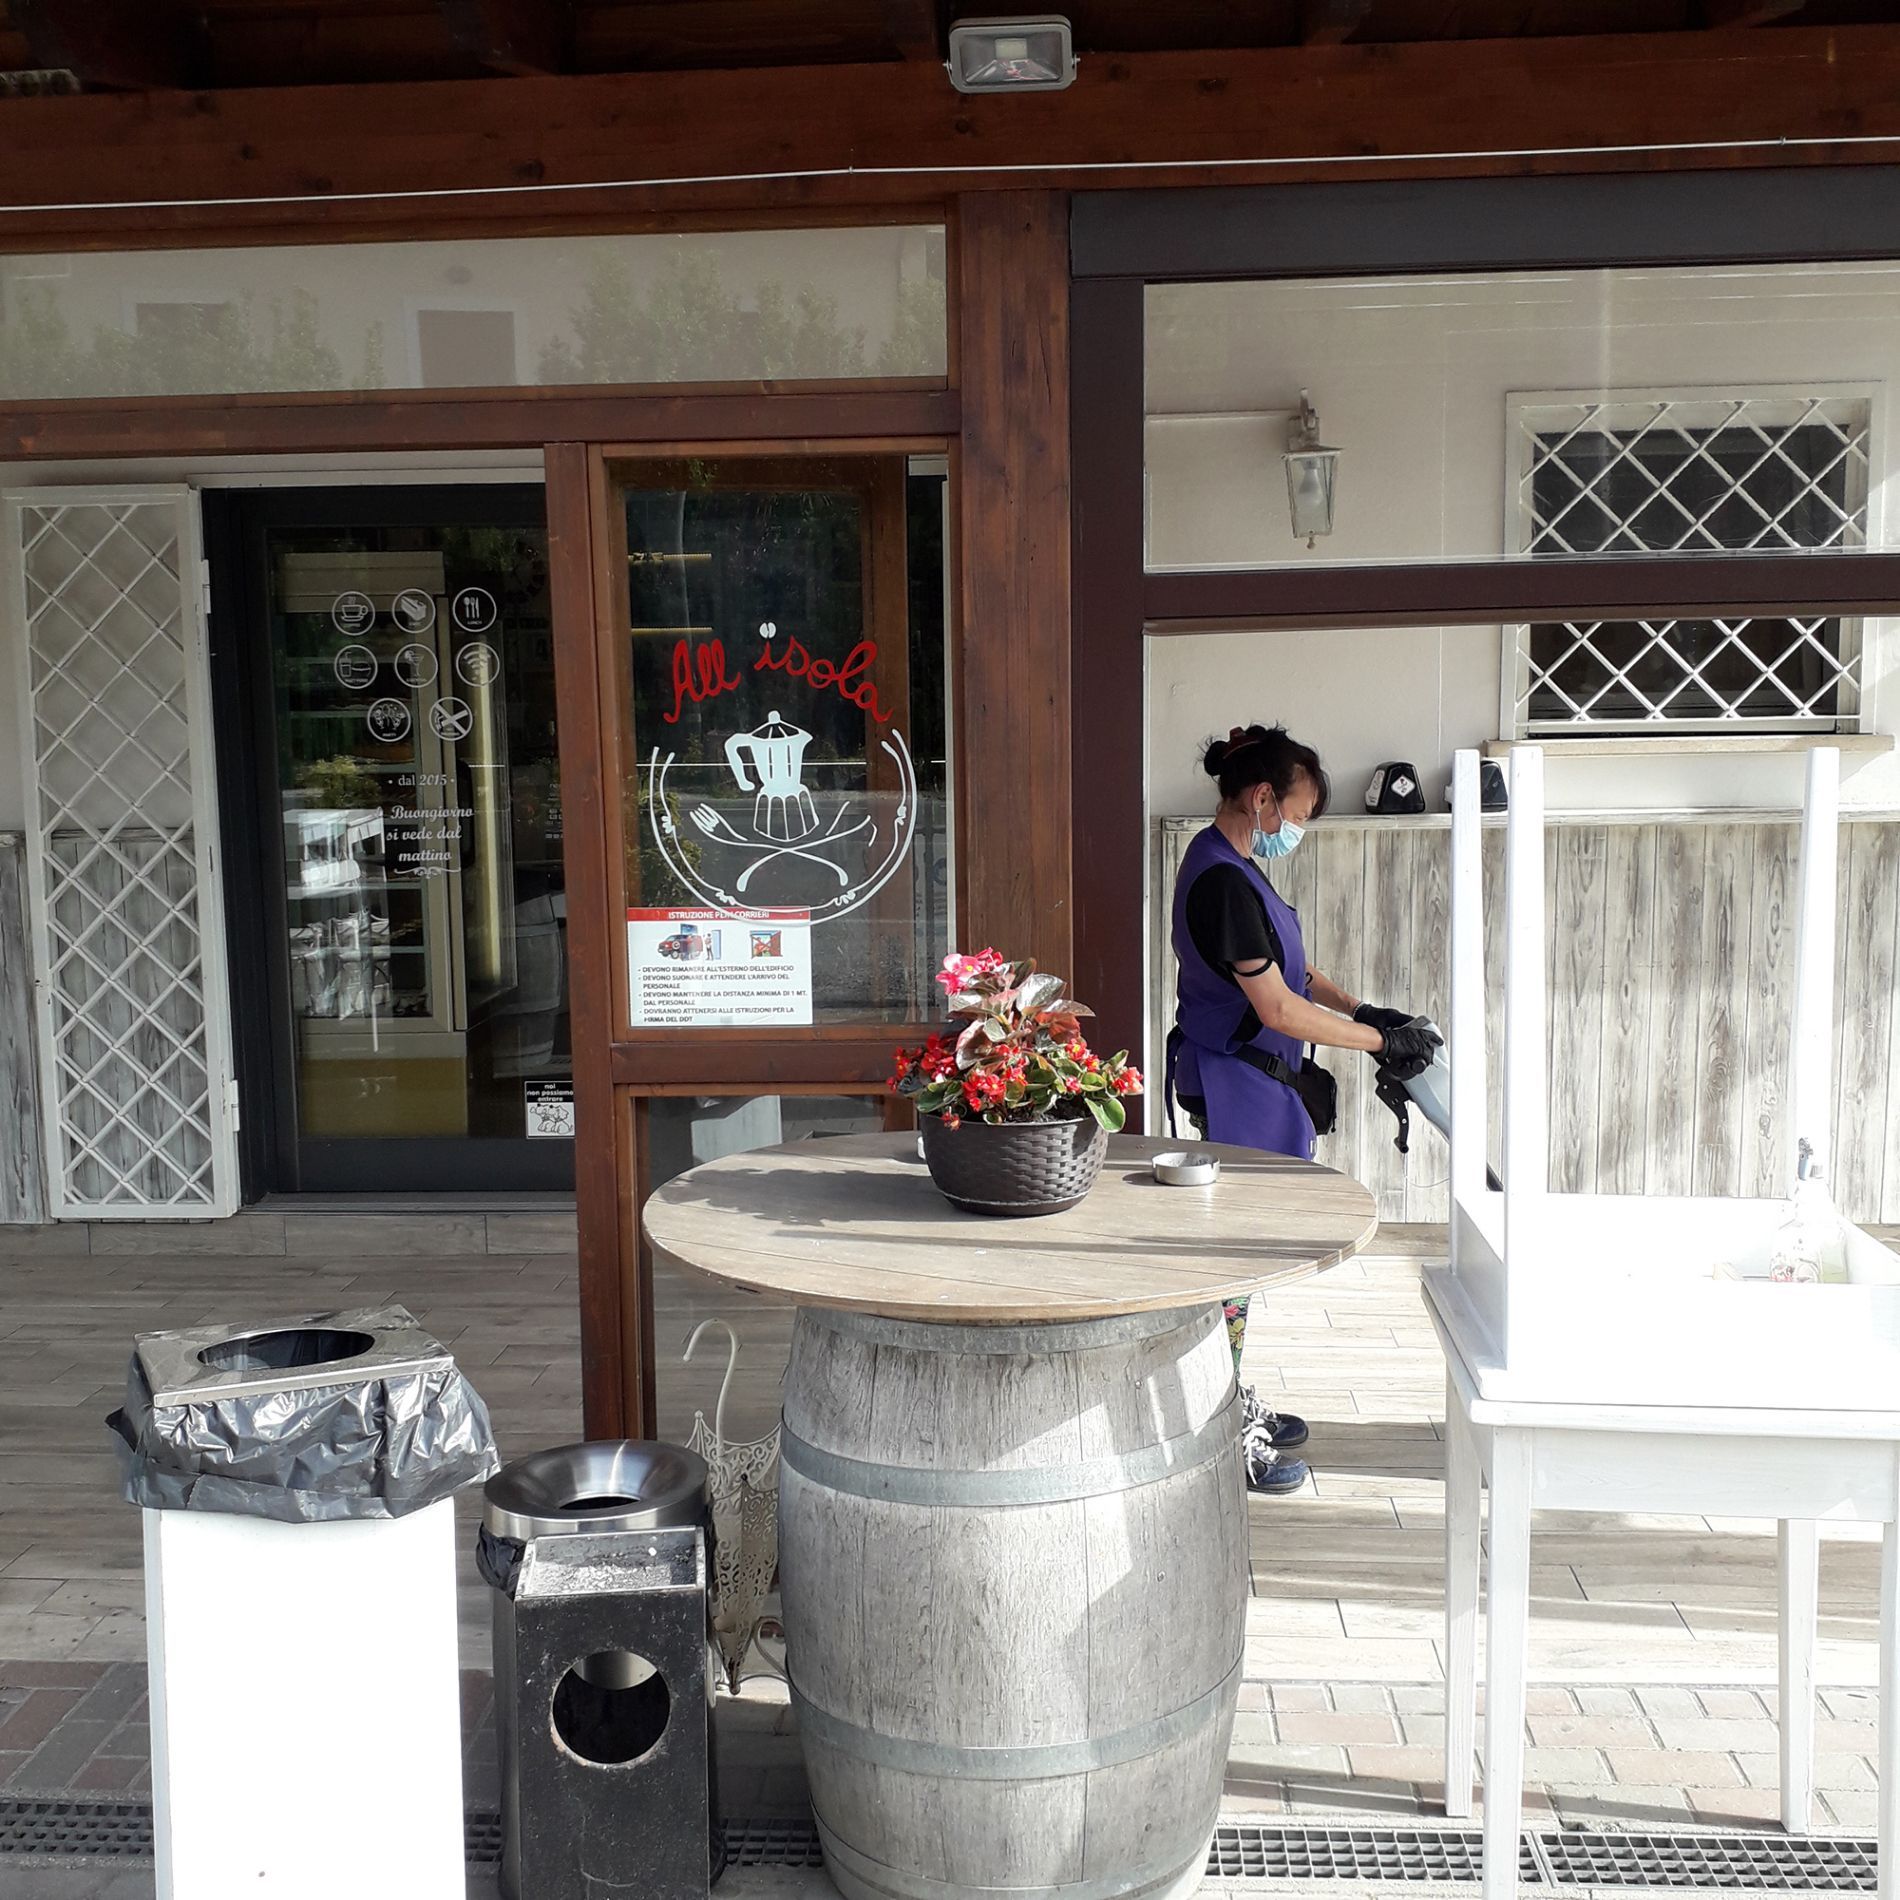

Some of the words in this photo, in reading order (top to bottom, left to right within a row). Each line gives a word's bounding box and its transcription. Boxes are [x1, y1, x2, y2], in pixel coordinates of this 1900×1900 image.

[663, 638, 741, 724] All
[754, 622, 893, 724] isola
[398, 774, 415, 786] dal
[419, 774, 448, 786] 2015
[390, 805, 475, 822] Buongiorno
[386, 828, 400, 841] si
[402, 826, 433, 840] vede
[436, 825, 462, 839] dal
[398, 848, 452, 862] mattino
[668, 911, 714, 919] ISTRUZIONE
[734, 910, 770, 918] CORRIERI
